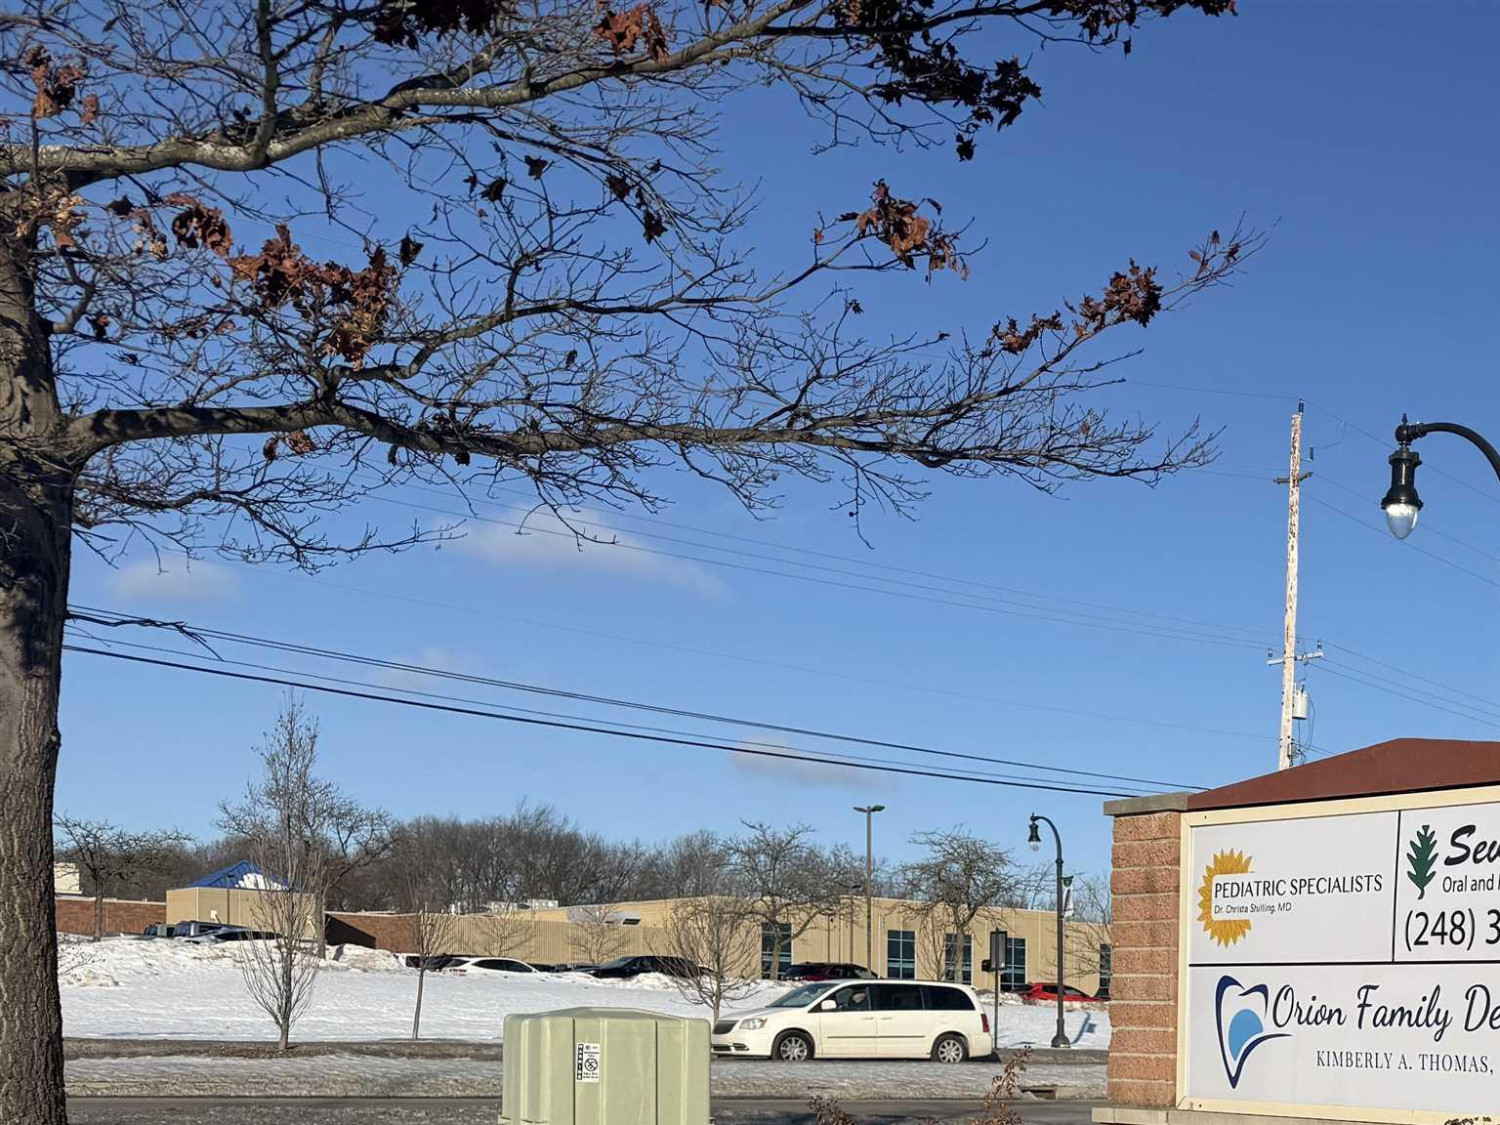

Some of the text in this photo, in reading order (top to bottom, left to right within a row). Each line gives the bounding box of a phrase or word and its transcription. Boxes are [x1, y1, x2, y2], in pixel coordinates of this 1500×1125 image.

[1214, 874, 1383, 898] PEDIATRIC SPECIALISTS
[1442, 874, 1467, 892] Oral
[1470, 874, 1494, 891] and
[1277, 902, 1292, 912] MD
[1405, 908, 1475, 952] (248)
[1272, 984, 1347, 1028] Orion
[1356, 984, 1453, 1043] Family
[1316, 1050, 1393, 1070] KIMBERLY
[1398, 1053, 1413, 1070] A.
[1418, 1053, 1494, 1075] THOMAS,
